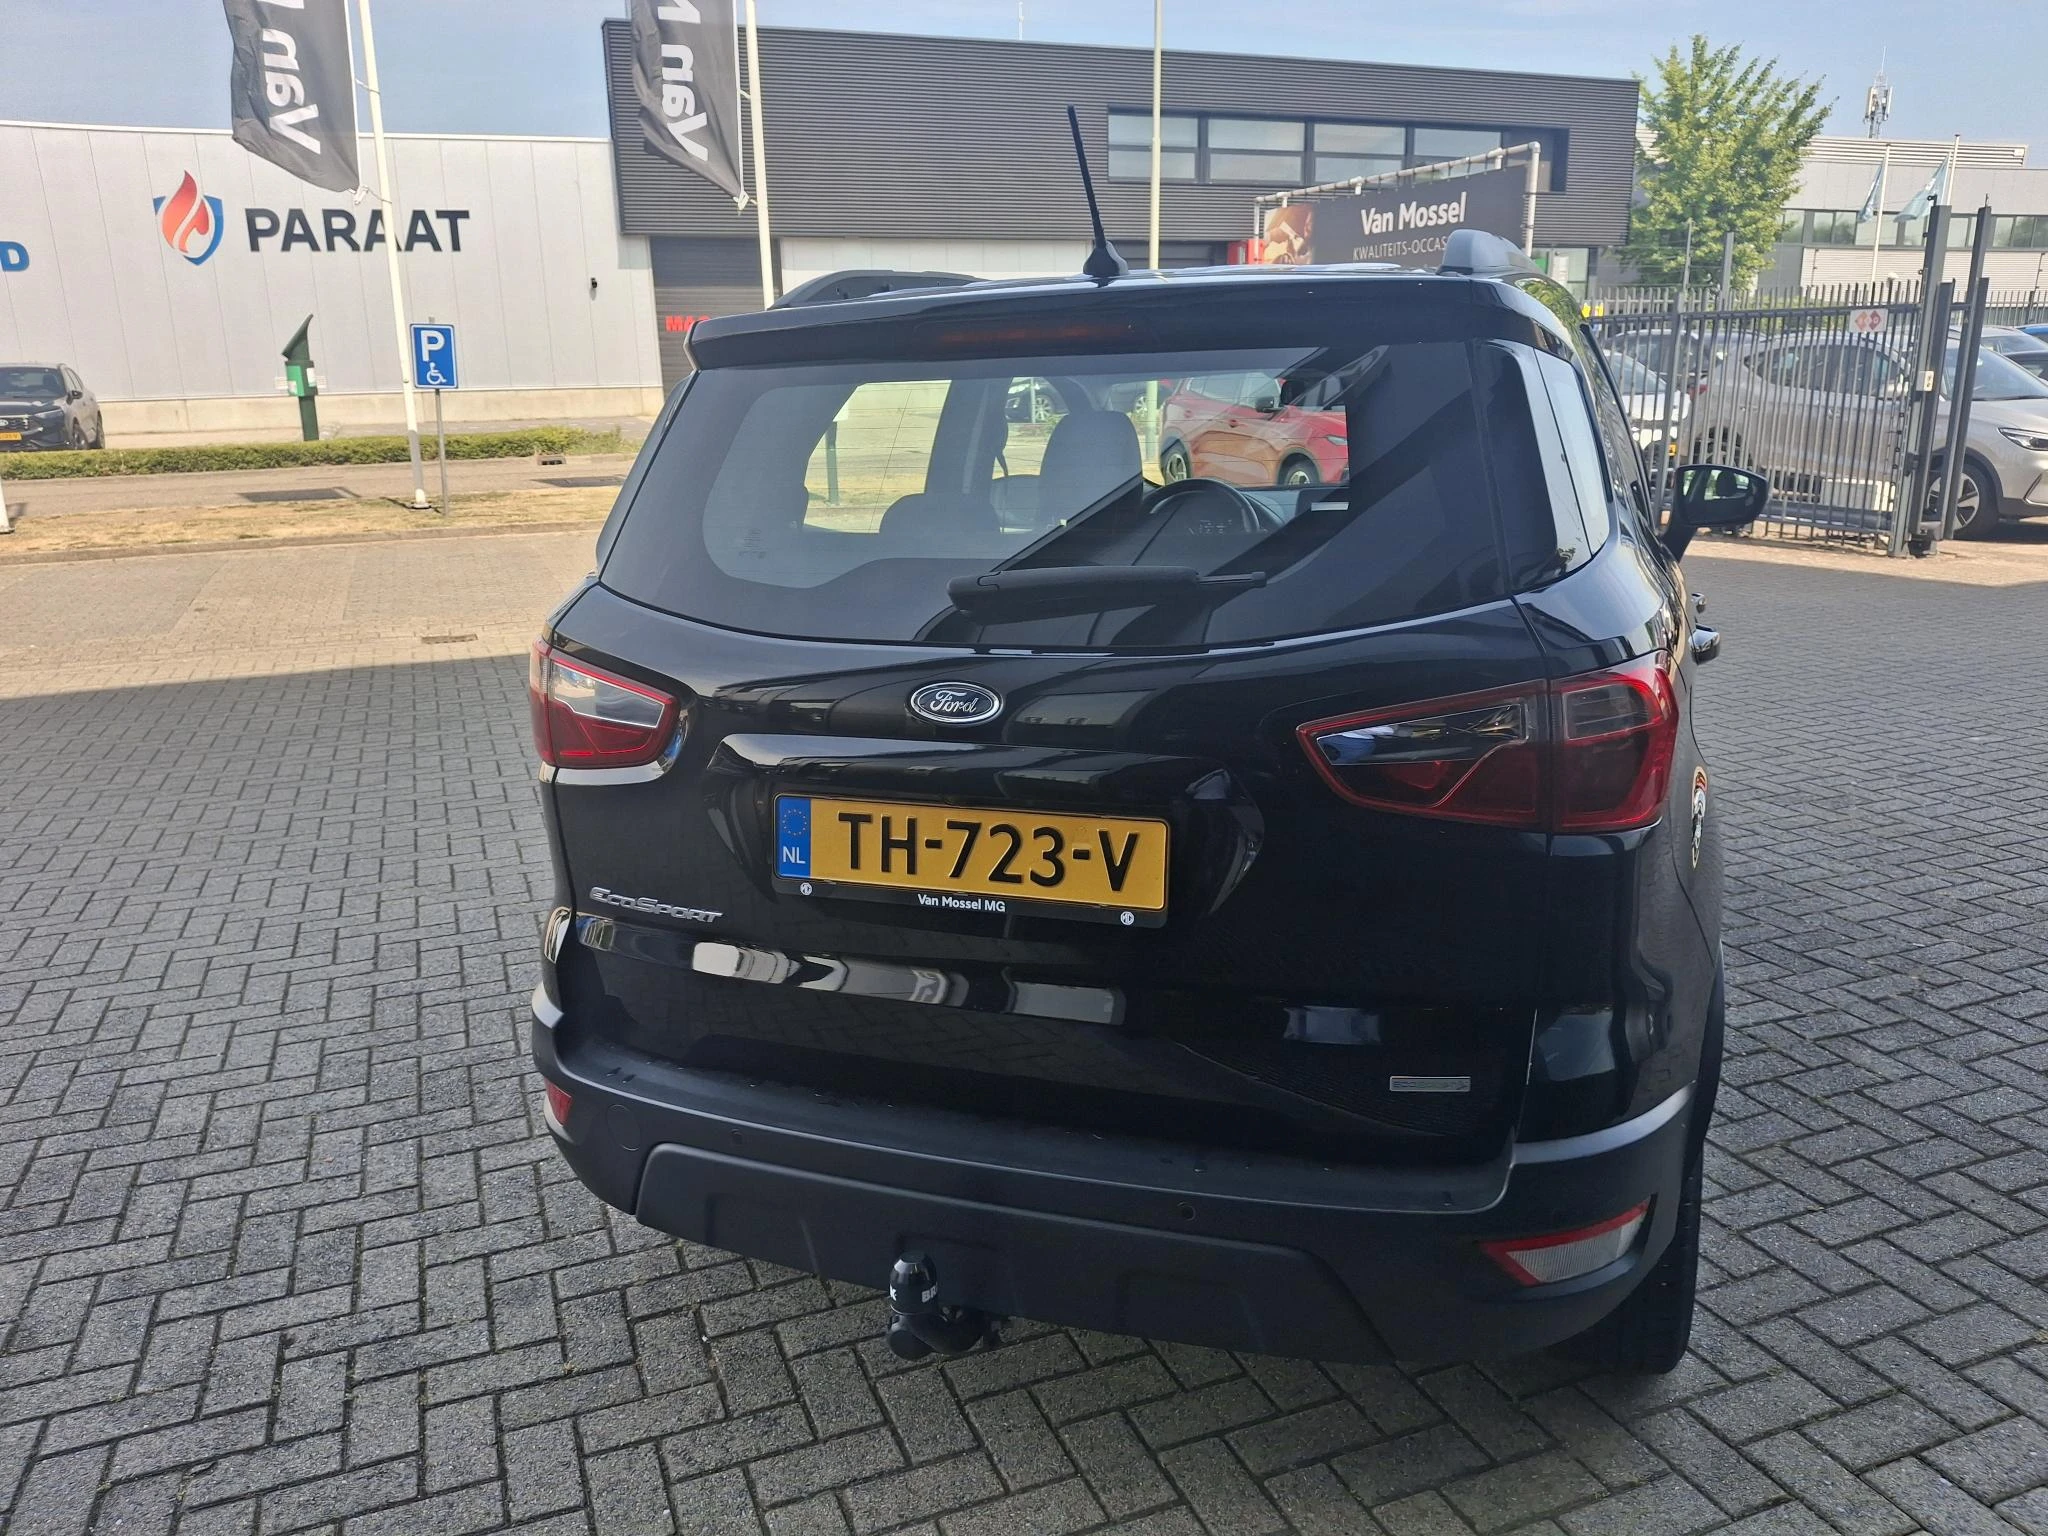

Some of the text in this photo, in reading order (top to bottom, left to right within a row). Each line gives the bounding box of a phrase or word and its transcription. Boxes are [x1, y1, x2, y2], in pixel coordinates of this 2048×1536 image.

[1361, 191, 1467, 235] Van Mossel
[245, 207, 470, 252] PARAAT
[421, 330, 445, 362] P
[929, 690, 979, 713] Ford
[782, 846, 806, 864] NL
[838, 811, 1140, 892] TH-723-V
[918, 893, 1006, 913] Van Mossel MG
